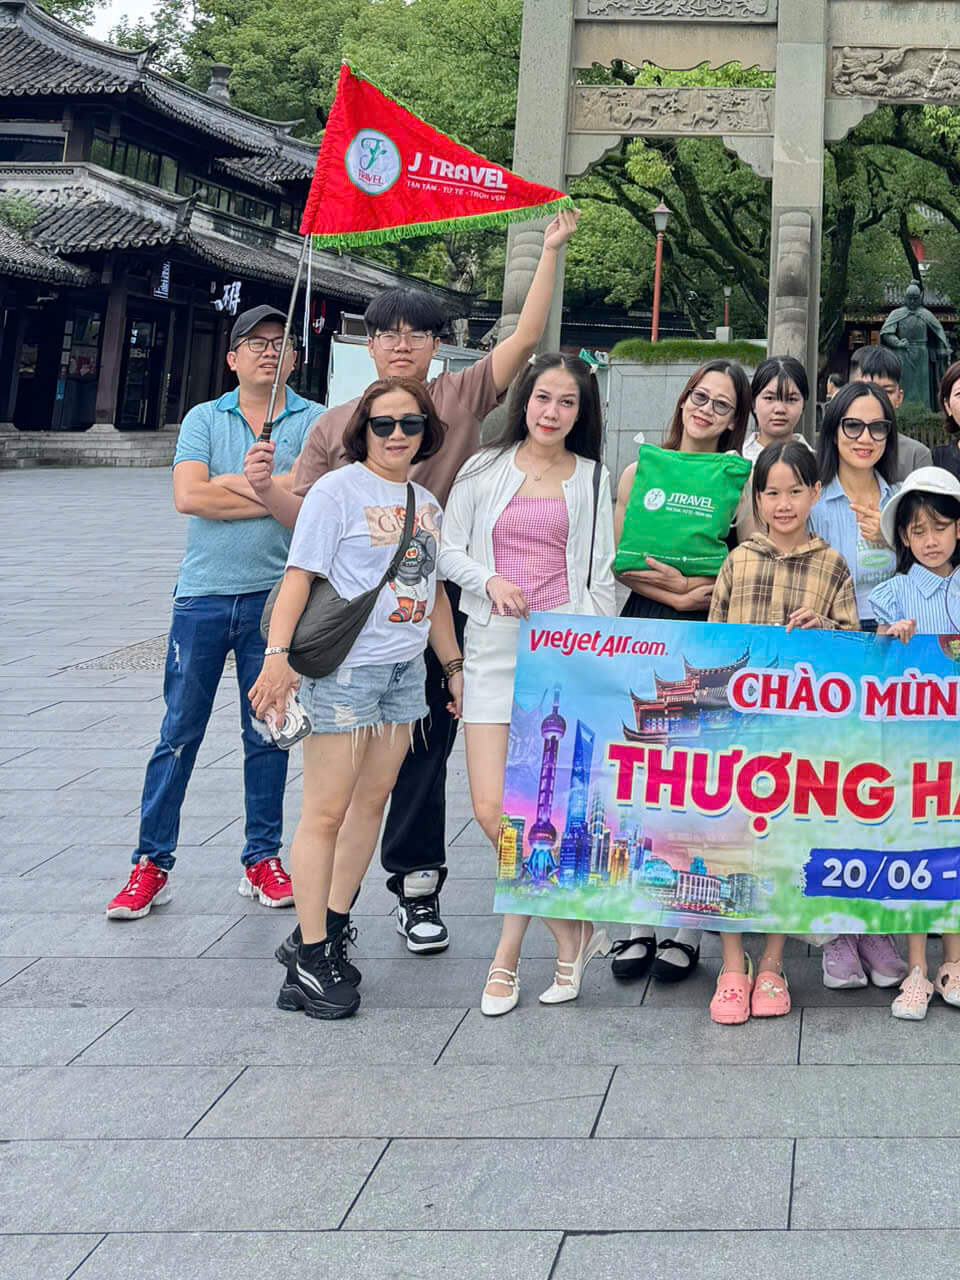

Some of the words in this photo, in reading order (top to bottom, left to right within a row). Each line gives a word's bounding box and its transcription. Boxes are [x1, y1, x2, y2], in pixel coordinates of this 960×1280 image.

[408, 152, 422, 172] J
[429, 156, 508, 189] TRAVEL
[732, 667, 851, 714] CHÀO
[608, 743, 895, 832] THƯỢNG
[822, 856, 932, 892] 20/06
